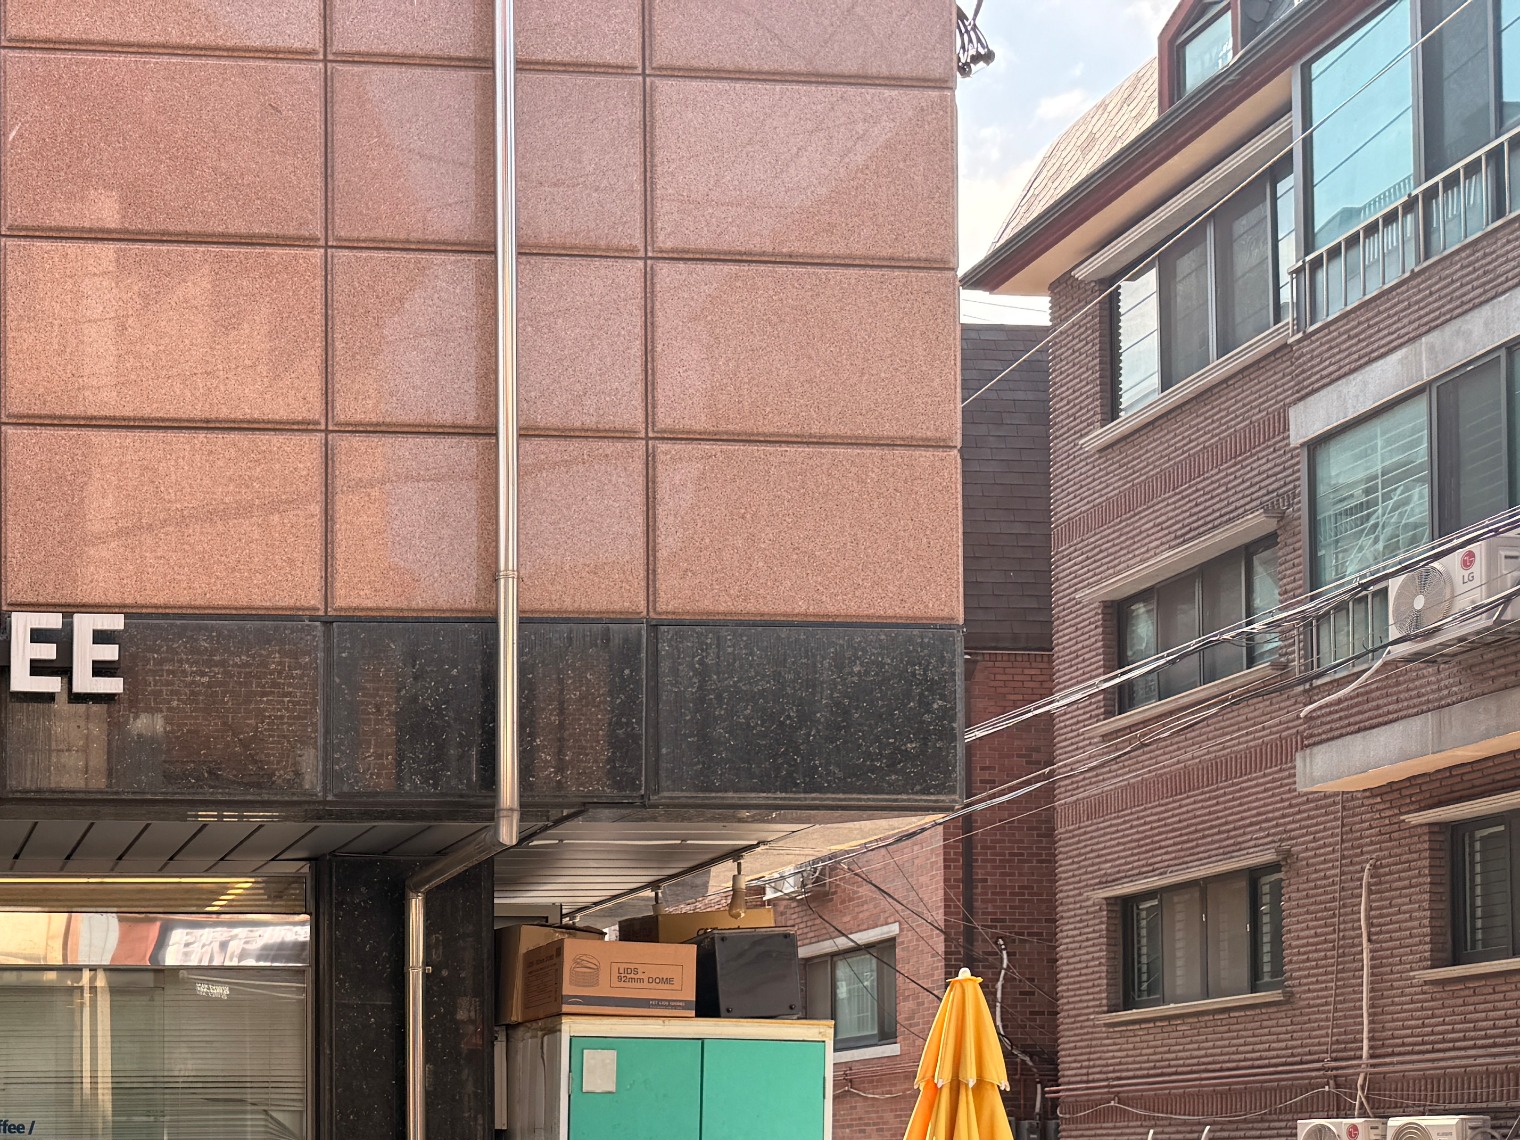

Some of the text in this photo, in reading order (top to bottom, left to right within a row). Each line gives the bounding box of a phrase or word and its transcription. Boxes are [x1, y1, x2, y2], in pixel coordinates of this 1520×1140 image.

[1462, 571, 1475, 585] LG
[617, 967, 639, 975] LIDS
[617, 975, 675, 985] 92mm DOME
